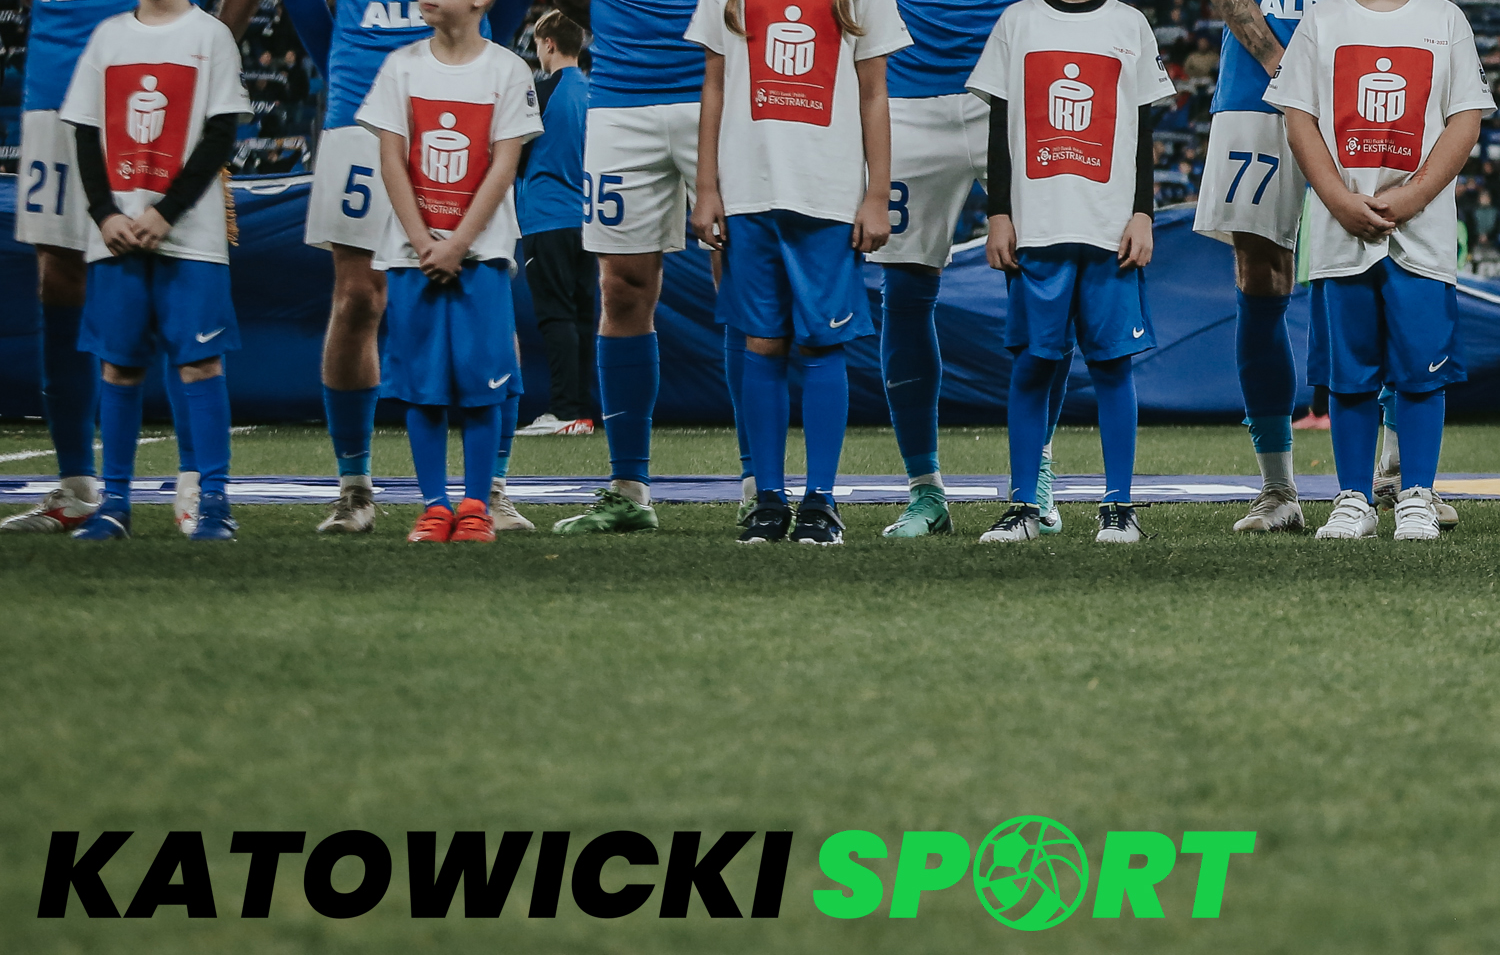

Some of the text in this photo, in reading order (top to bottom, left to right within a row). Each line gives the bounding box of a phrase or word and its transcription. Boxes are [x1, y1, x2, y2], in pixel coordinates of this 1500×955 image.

[768, 95, 824, 110] EKSTRAKLASA
[1052, 150, 1101, 167] EKSTRAKLASA
[1363, 144, 1412, 156] EKSTRAKLASA
[26, 160, 70, 216] 21
[342, 164, 375, 219] 5
[1225, 151, 1280, 205] 77
